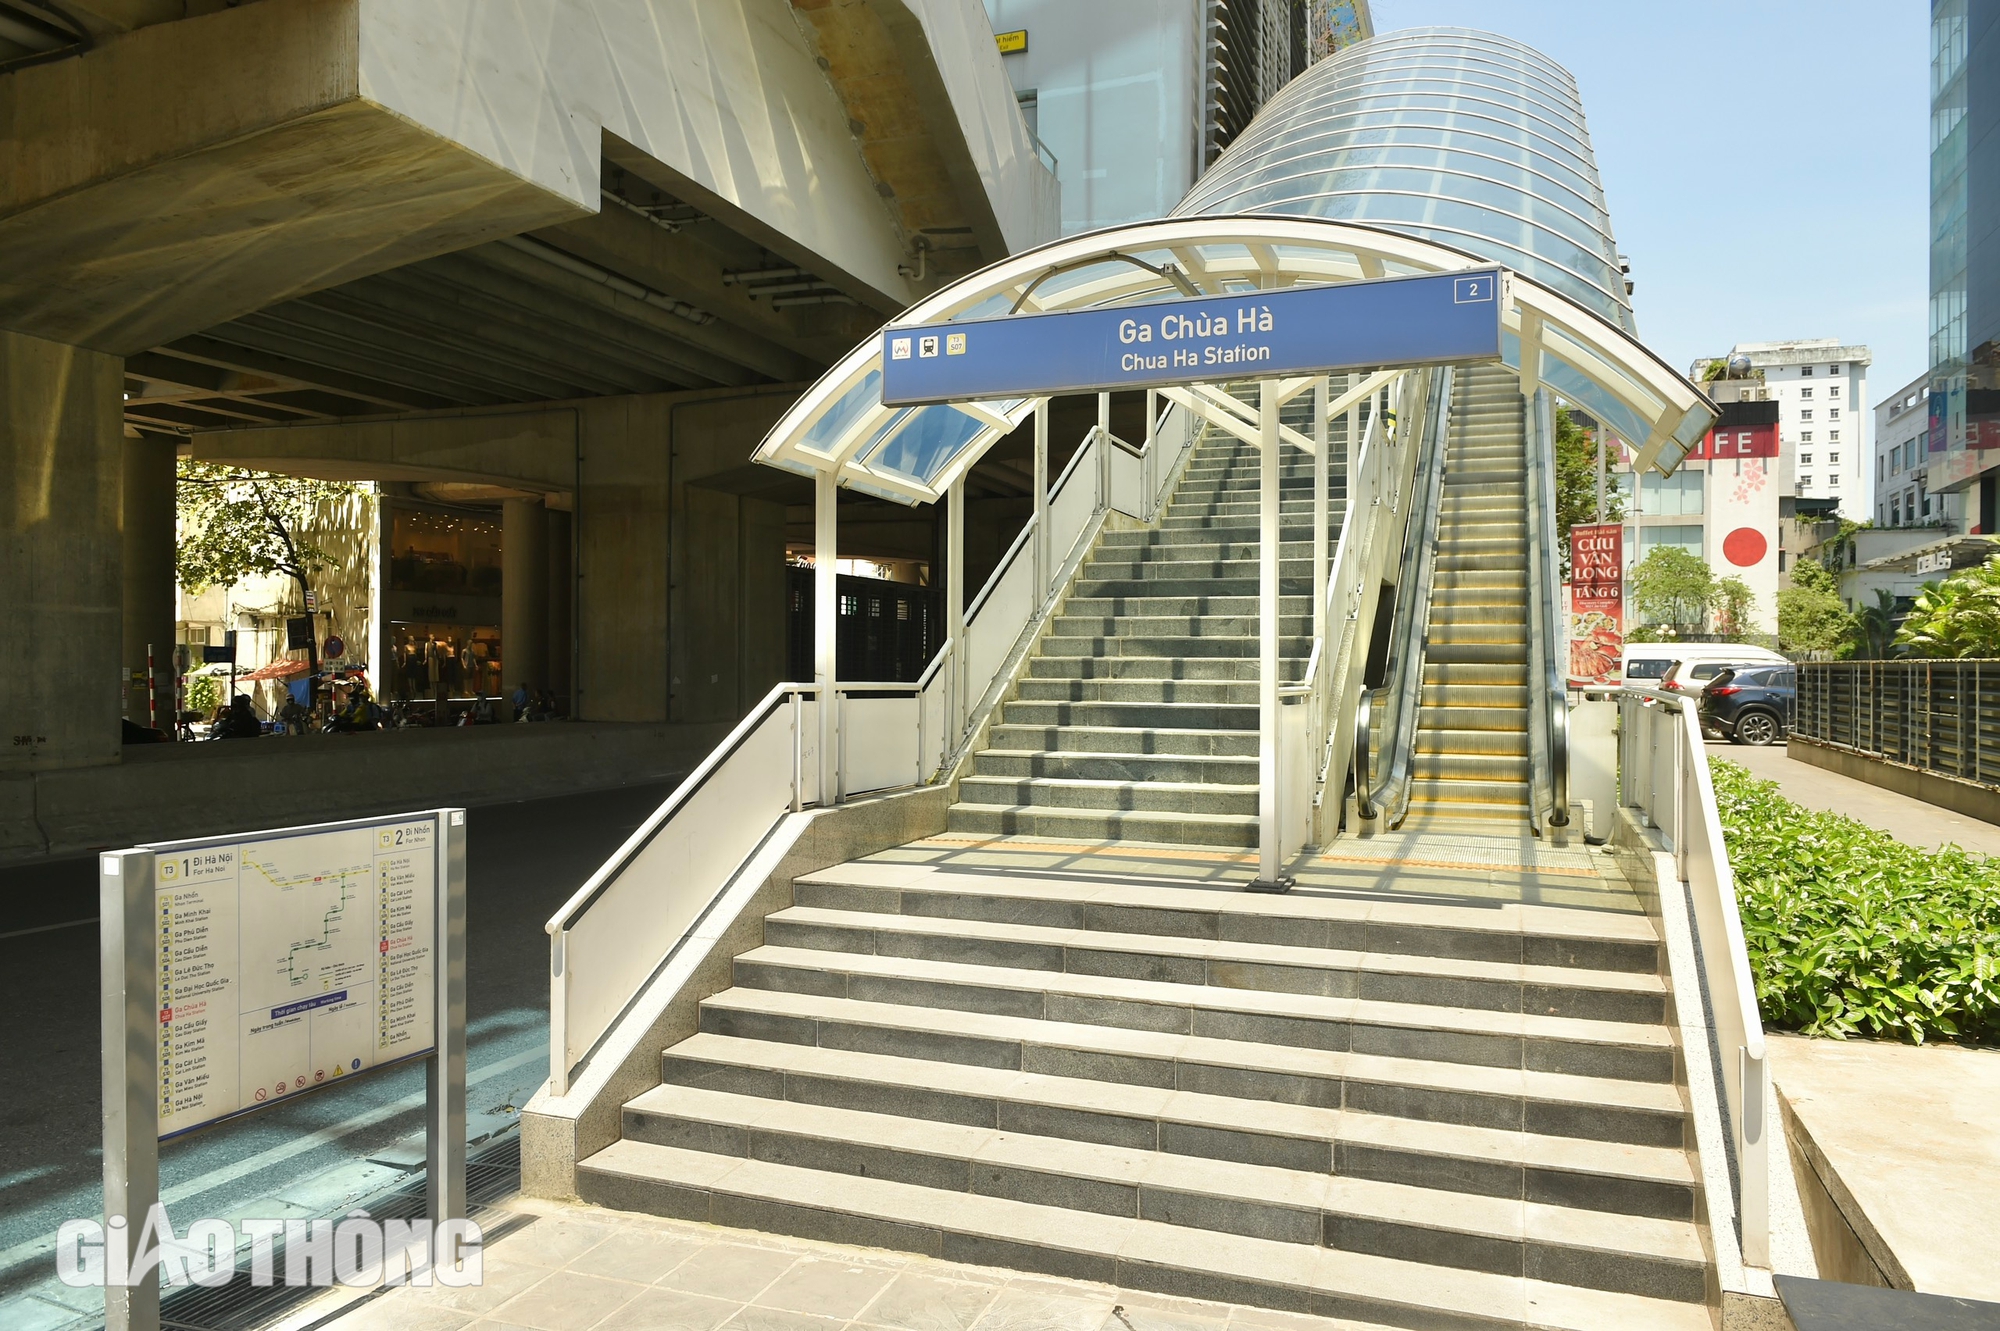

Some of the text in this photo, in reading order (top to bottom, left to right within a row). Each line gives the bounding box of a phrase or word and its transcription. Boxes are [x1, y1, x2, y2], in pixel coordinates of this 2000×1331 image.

[1470, 283, 1478, 296] 2
[1119, 306, 1274, 344] Ga Chùa Hà
[1121, 345, 1270, 372] Chua Ha Station
[1578, 536, 1614, 551] CỬU
[1580, 551, 1612, 565] VÂN
[1575, 566, 1618, 580] LONG
[1610, 587, 1618, 597] 6
[396, 830, 403, 845] 2
[194, 853, 232, 866] Đi Hà Nội
[183, 859, 188, 877] 1
